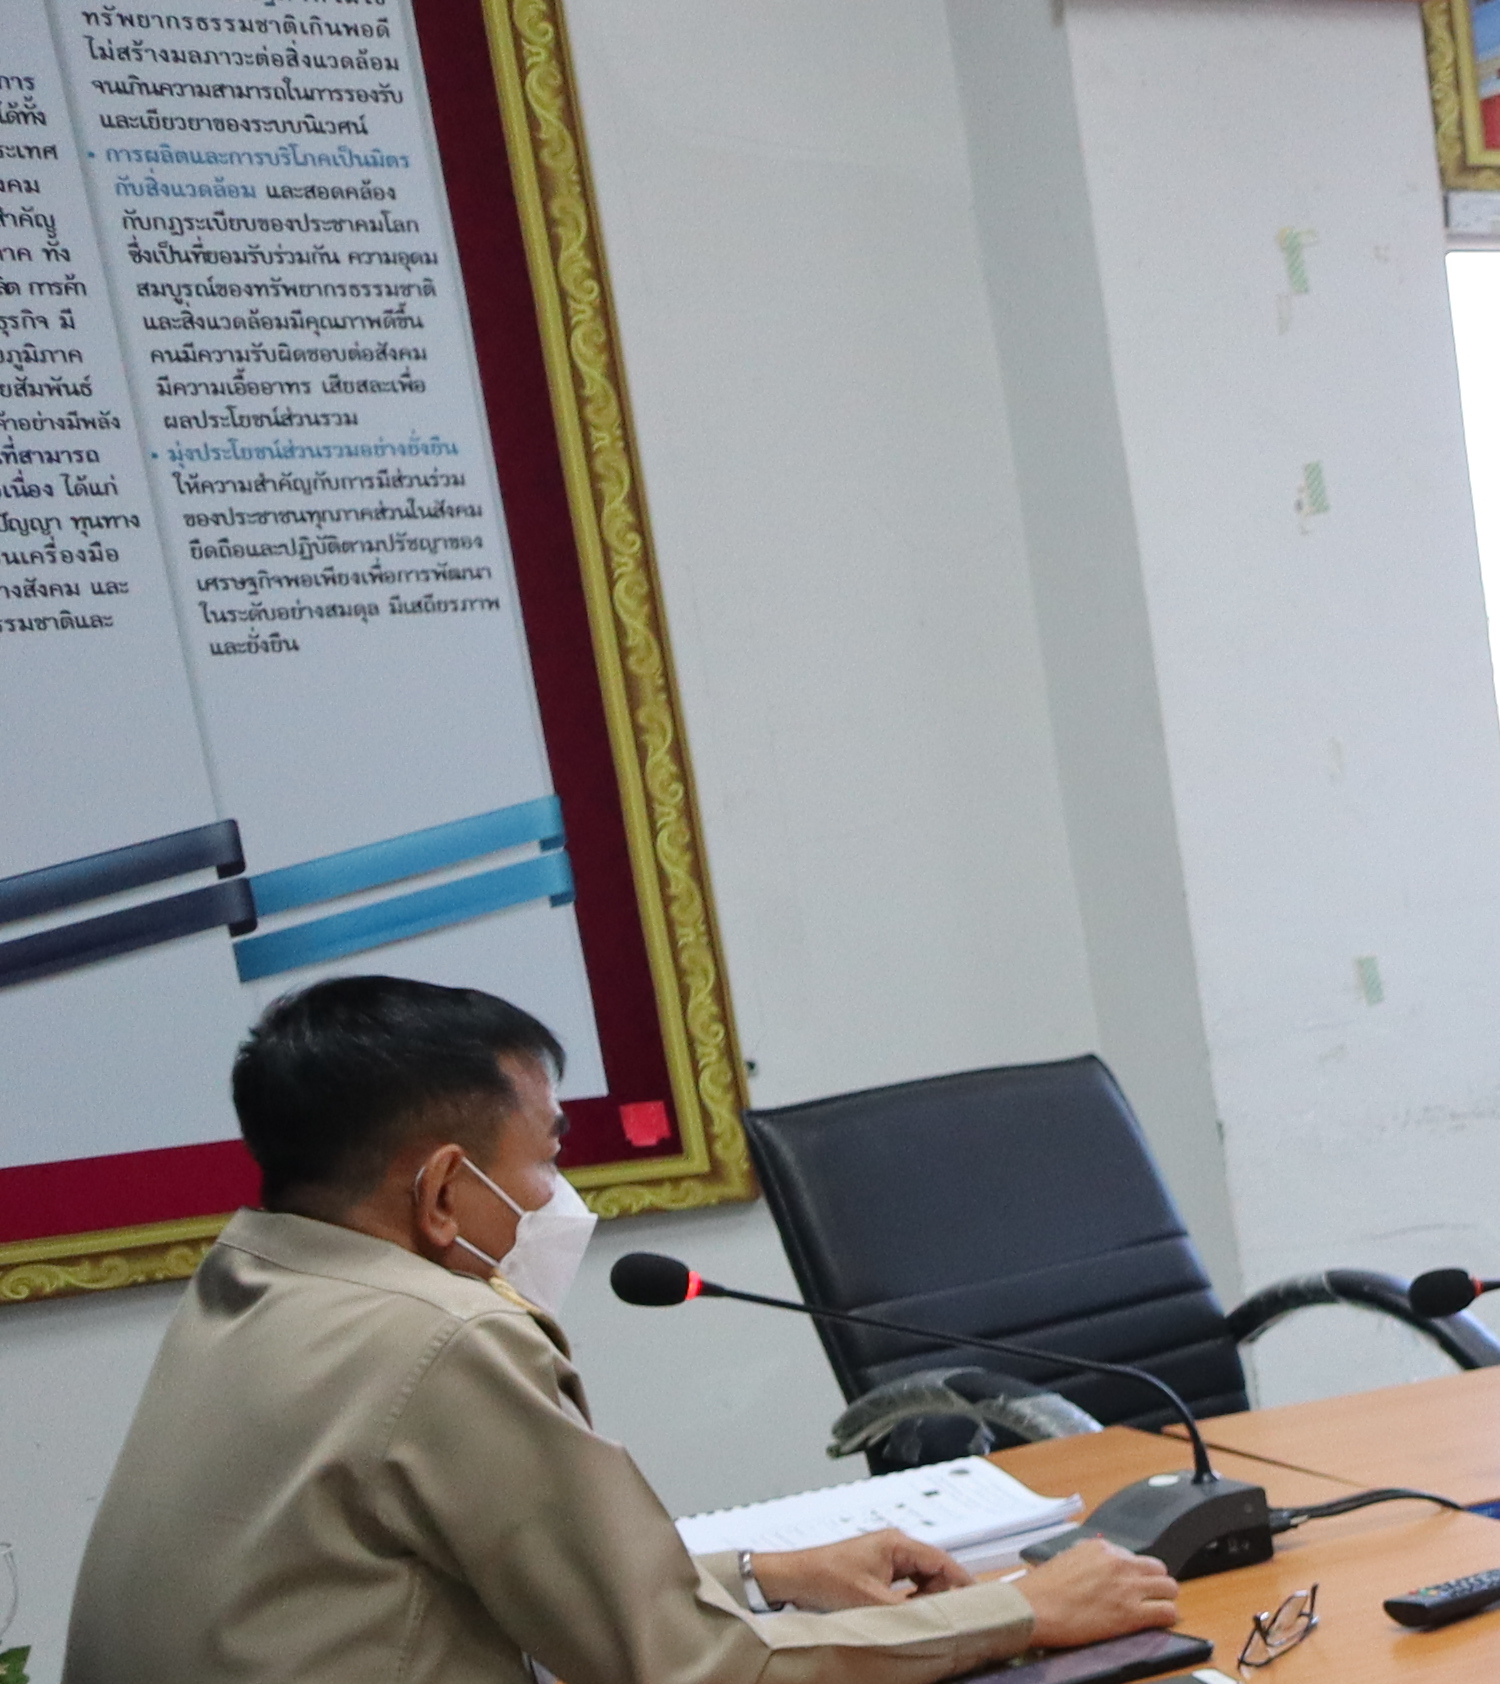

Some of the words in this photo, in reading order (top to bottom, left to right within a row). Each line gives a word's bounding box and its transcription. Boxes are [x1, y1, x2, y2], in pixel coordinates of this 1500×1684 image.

[82, 5, 390, 39] ทรัพยากรธรรมชาติเกินพอดี
[83, 36, 399, 72] ไม่สร้างมลภาวะต่อสิ่งแวดล้อม
[91, 75, 404, 104] จนเกินความสามารถในการรองรับ
[100, 109, 369, 136] และเยียวยาของระบบนิเวศน์
[115, 168, 257, 199] กับสิ่งแวดล้อม
[265, 180, 397, 201] และสอดคล้อง
[42, 232, 70, 263] ทั้ง
[348, 250, 439, 273] ความอุดม
[29, 273, 87, 296] การค้า
[137, 275, 437, 305] สมบูรณ์ของทรัพยากรธรรมชาติ
[59, 308, 75, 330] มี
[143, 302, 424, 336] และสิ่งแวดล้อมมีคุณภาพดีขึ้น
[150, 341, 428, 366] คนมีความรับผิดชอบต่อสังคม
[156, 368, 312, 397] มีความเอื้ออาทร
[321, 366, 427, 395] เสียสละเพื่อ
[164, 405, 360, 431] ผลประโยชน์ส่วนรวม
[60, 473, 118, 497] ได้แก่
[172, 467, 467, 497] ให้ความสำคัญกับการมีส่วนร่วม
[70, 513, 141, 538] ทุนทาง
[183, 498, 483, 531] ของประชาชนทุกภาคส่วนในสังคม
[91, 580, 129, 596] และ
[196, 557, 493, 595] เศรษฐกิจพอเพียงเพื่อการพัฒนา
[198, 598, 379, 626] ในระดับอย่างสมดุล
[210, 626, 300, 657] และยั่งยืน
